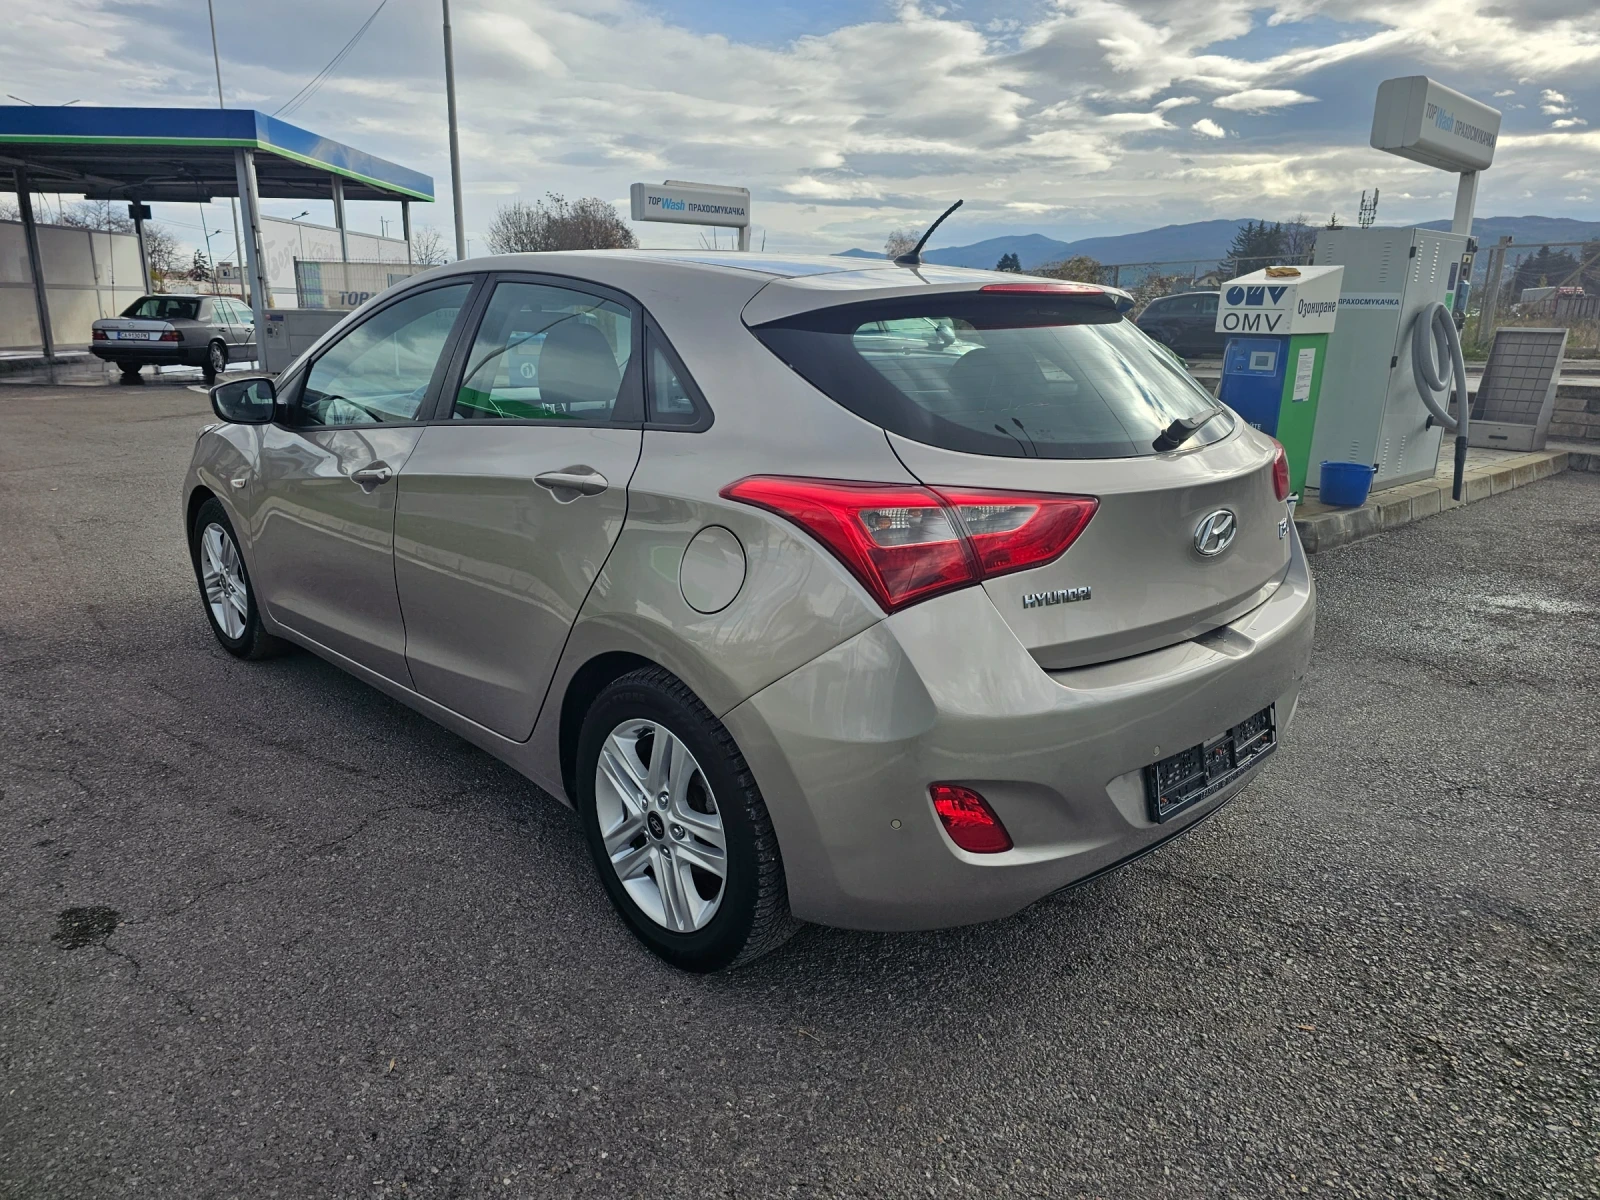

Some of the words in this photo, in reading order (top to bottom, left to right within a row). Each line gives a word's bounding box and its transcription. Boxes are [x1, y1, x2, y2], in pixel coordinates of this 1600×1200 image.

[1454, 120, 1495, 148] ПРАХОСМУКАЧКА
[688, 203, 745, 216] ПРАХОСМУКАЧКА
[338, 291, 377, 306] TOP
[1298, 299, 1336, 317] Озониране
[1223, 313, 1282, 331] OMV
[1022, 586, 1092, 609] HYUNDAI
